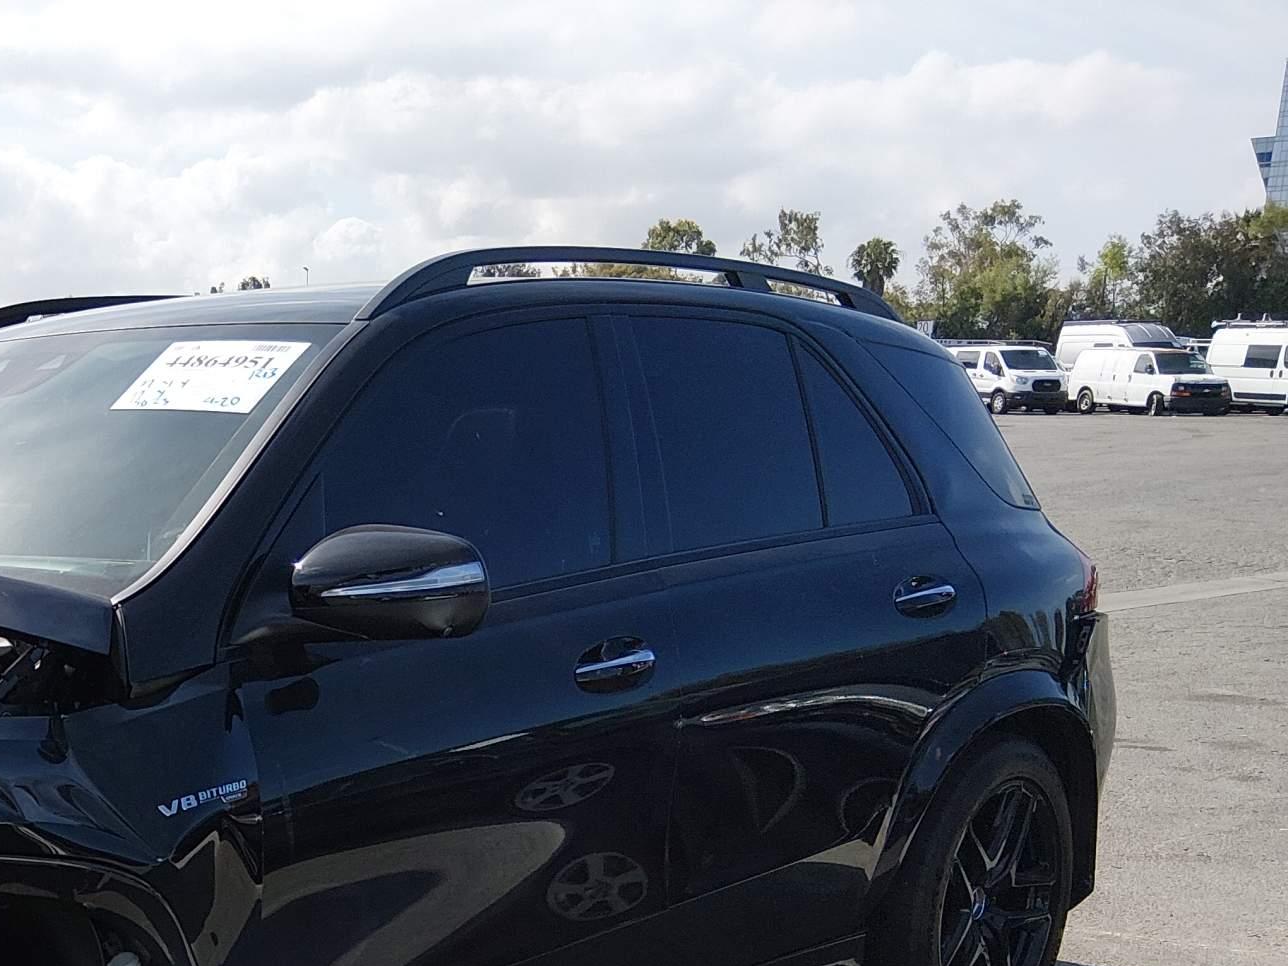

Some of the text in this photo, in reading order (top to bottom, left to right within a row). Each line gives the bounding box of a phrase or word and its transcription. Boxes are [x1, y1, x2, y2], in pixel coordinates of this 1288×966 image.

[165, 355, 276, 369] 44864951
[157, 794, 198, 817] V8
[198, 780, 247, 801] BITURBO
